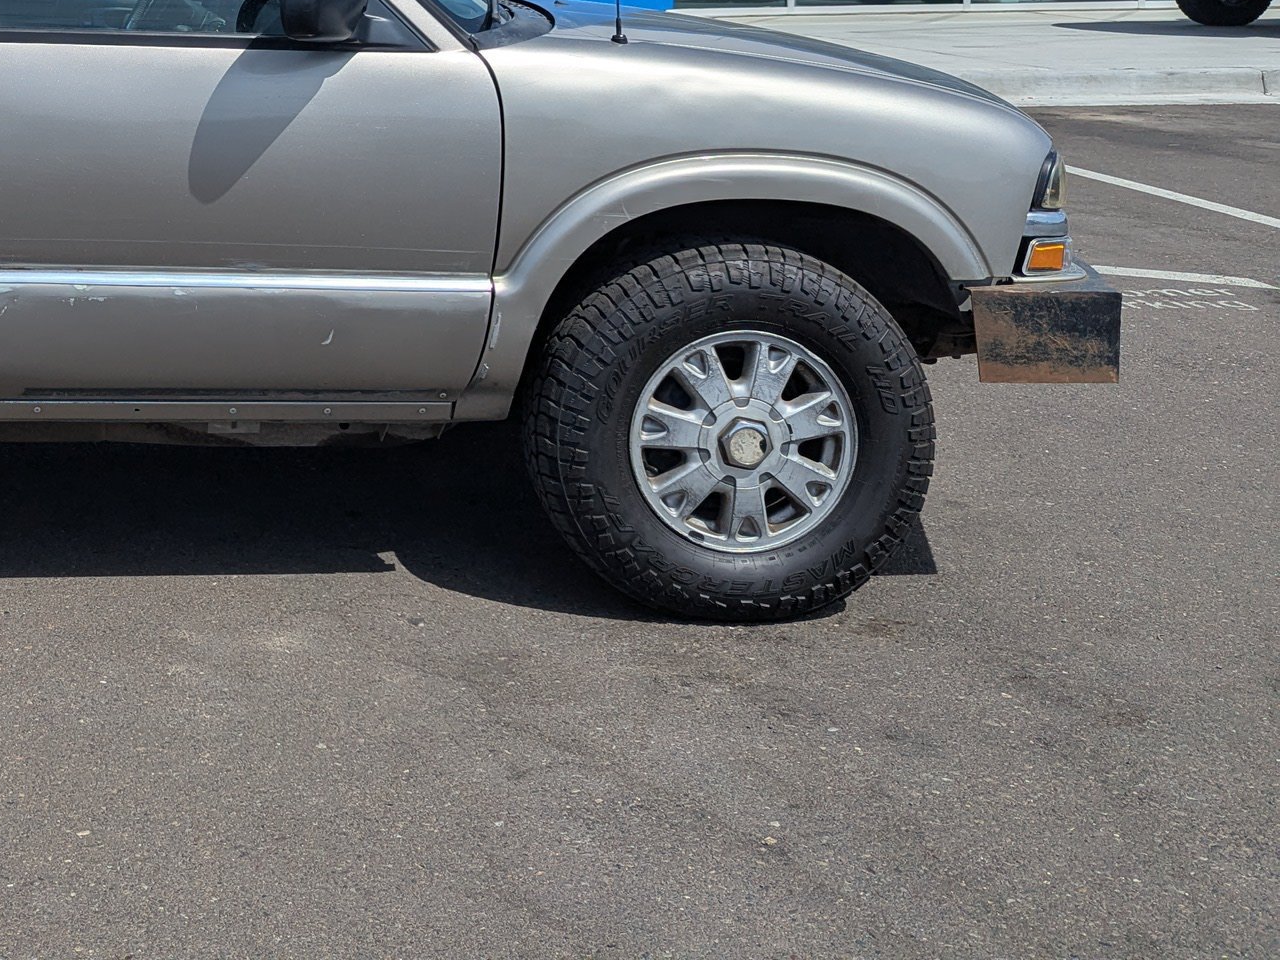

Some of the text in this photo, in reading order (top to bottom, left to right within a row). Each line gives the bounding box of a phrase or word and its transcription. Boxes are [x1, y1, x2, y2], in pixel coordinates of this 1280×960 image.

[1122, 288, 1236, 297] omer
[1122, 298, 1260, 311] rking
[596, 293, 899, 424] COURSER TRAIL HD
[598, 487, 857, 597] MASTERCRAFT
